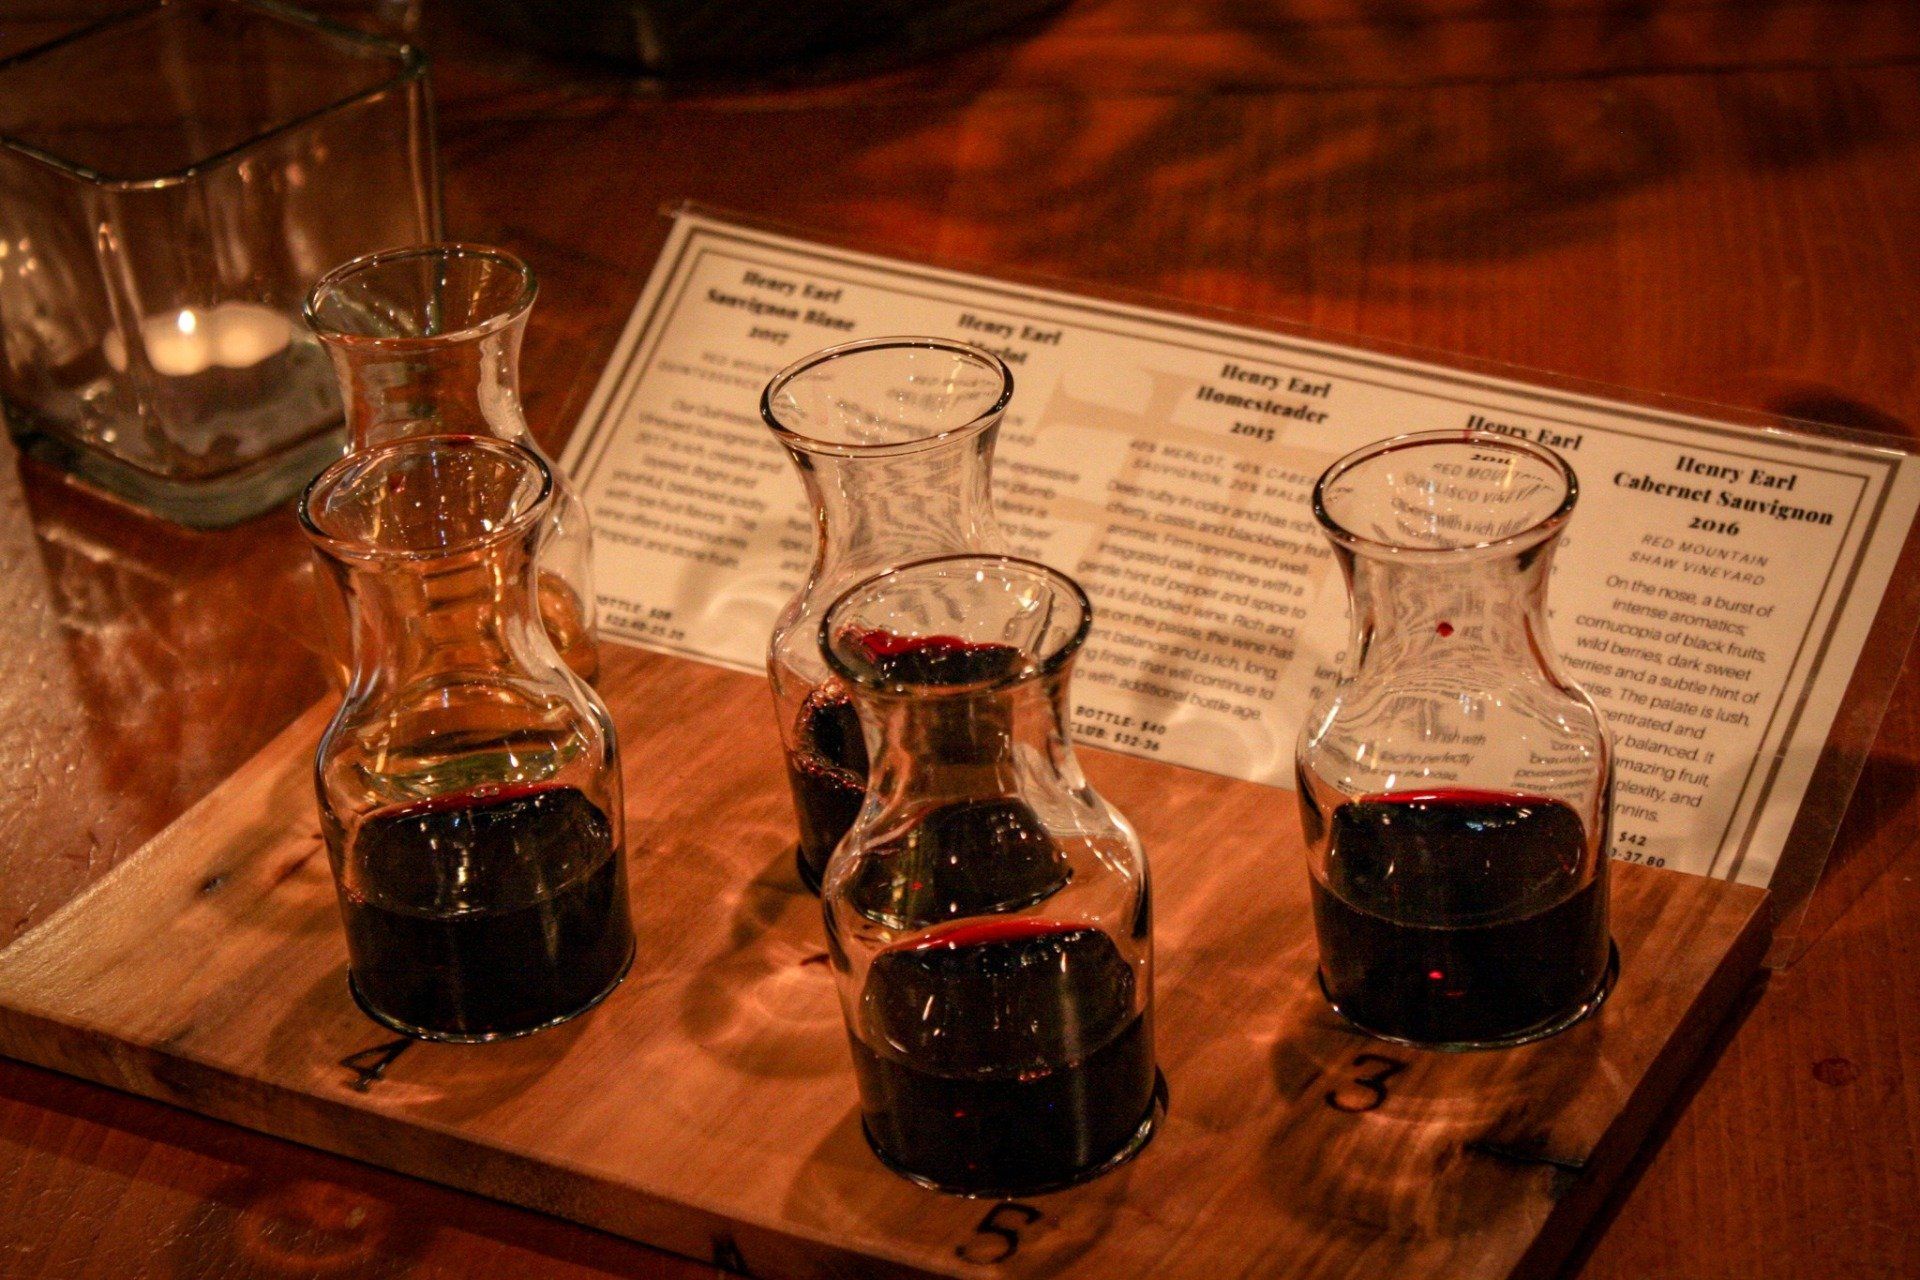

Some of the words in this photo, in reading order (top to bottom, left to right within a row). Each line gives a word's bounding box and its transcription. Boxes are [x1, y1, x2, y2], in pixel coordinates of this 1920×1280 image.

[742, 271, 797, 297] Henry
[802, 284, 843, 303] Earl
[958, 313, 1014, 340] Henry
[1020, 325, 1063, 346] Earl
[1220, 363, 1280, 390] Henry
[1287, 376, 1332, 398] Earl
[1196, 385, 1329, 424] Homesteader
[1230, 422, 1276, 442] 2015
[1537, 431, 1584, 451] Earl
[1675, 455, 1744, 484] Henry
[1749, 469, 1798, 491] Earl
[1612, 471, 1712, 503] Cabernet
[1716, 491, 1834, 526] Sauvignon
[1231, 508, 1262, 523] and
[1263, 512, 1289, 529] has
[1688, 515, 1741, 537] 2016
[1198, 520, 1229, 537] and
[1228, 526, 1300, 555] blackberry
[1641, 534, 1675, 549] RED
[1678, 541, 1769, 567] MOUNTAIN
[1248, 552, 1279, 569] and
[1629, 551, 1678, 570] SHAW
[1683, 562, 1766, 587] VINEYARD
[1166, 580, 1220, 602] pepper
[1220, 590, 1250, 607] and
[1250, 597, 1290, 615] spice
[1290, 604, 1307, 620] to
[1261, 577, 1293, 594] with
[1294, 585, 1304, 597] a
[1605, 575, 1630, 589] On
[1631, 579, 1657, 596] the
[1702, 595, 1713, 607] a
[1713, 596, 1755, 615] burst
[1755, 604, 1776, 618] of
[1205, 630, 1230, 646] the
[1232, 613, 1264, 631] Rich
[1264, 623, 1296, 639] and
[1663, 630, 1682, 645] of
[1682, 633, 1725, 654] black
[1169, 643, 1200, 661] and
[1199, 652, 1210, 664] a
[1576, 635, 1609, 653] wild
[1667, 654, 1702, 672] dark
[1702, 662, 1752, 681] sweet
[1168, 667, 1193, 681] will
[1193, 671, 1256, 697] continue
[1258, 687, 1275, 701] to
[1614, 665, 1647, 683] and
[1646, 674, 1659, 685] a
[1659, 674, 1709, 696] subtle
[1708, 684, 1741, 702] hint
[1741, 692, 1762, 706] of
[1189, 692, 1232, 712] bottle
[1619, 687, 1649, 705] The
[1649, 694, 1699, 717] palate
[1700, 704, 1714, 719] is
[1673, 721, 1707, 740] and
[1669, 790, 1704, 809] and
[1619, 830, 1648, 848] $42
[341, 1038, 412, 1091] 4
[1325, 1052, 1408, 1114] 3
[956, 1199, 1042, 1265] 5
